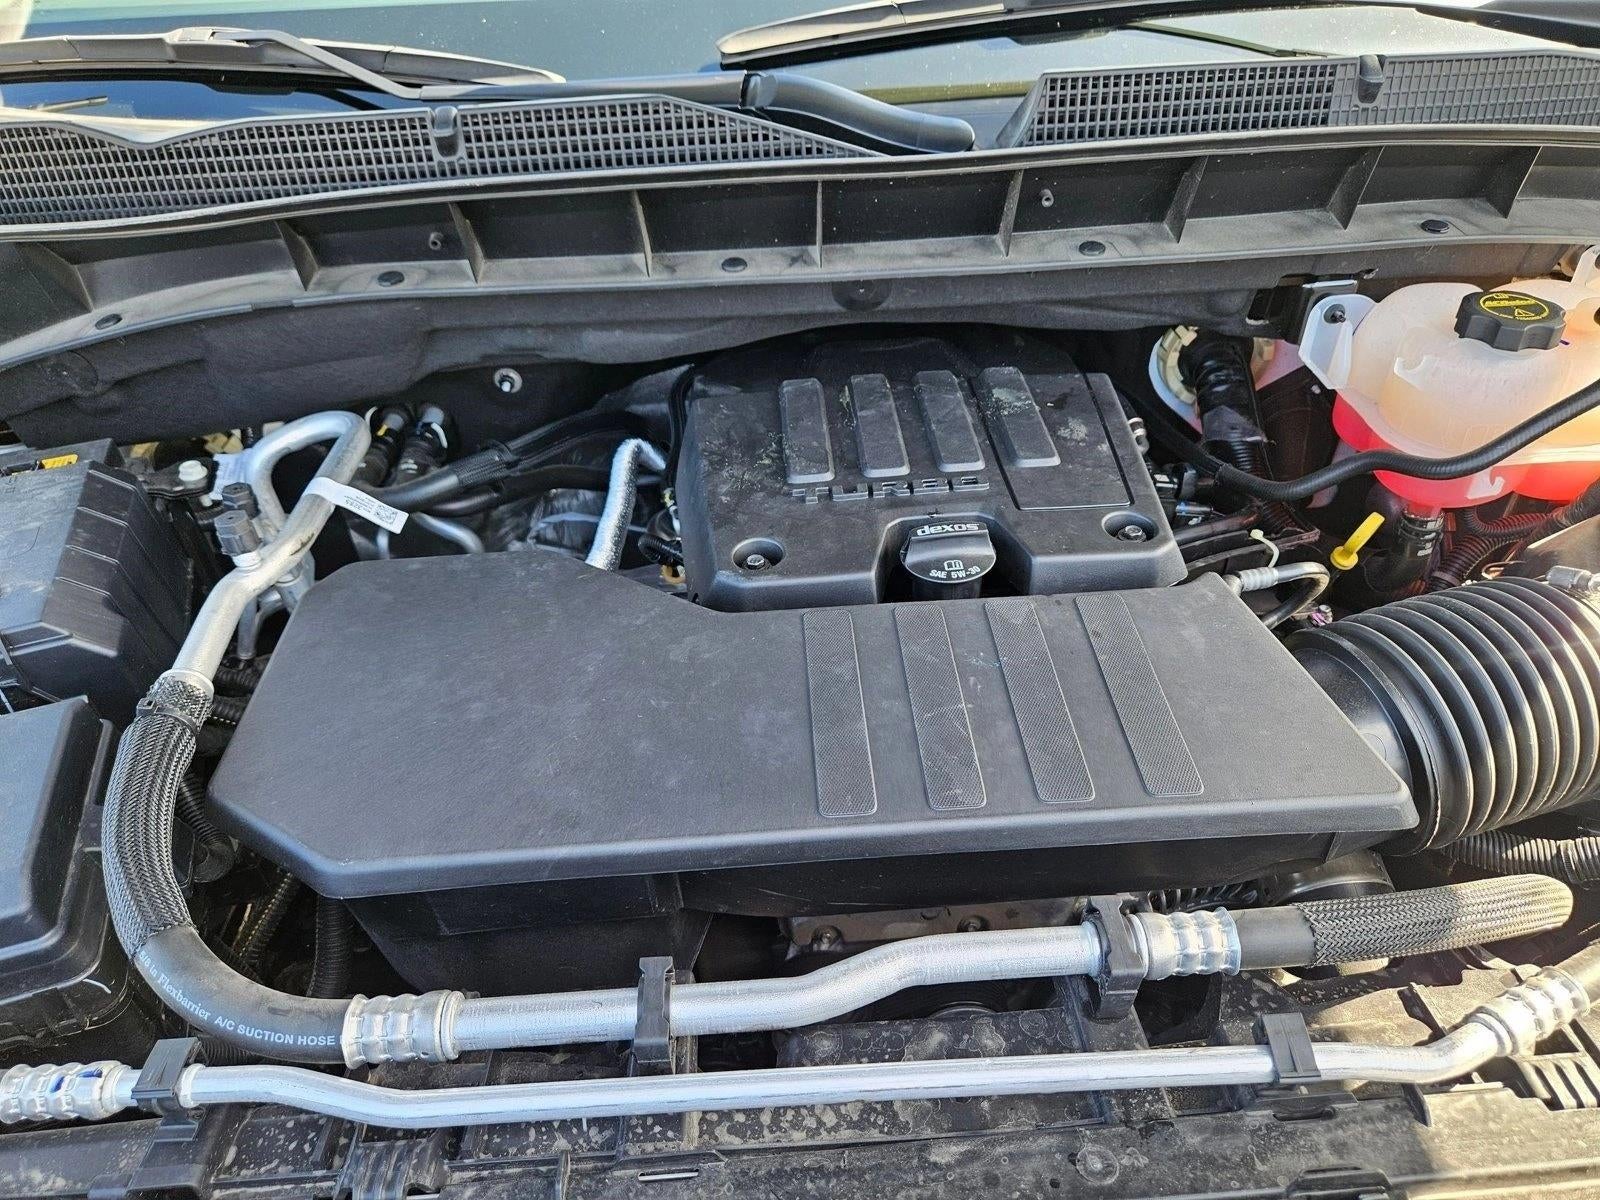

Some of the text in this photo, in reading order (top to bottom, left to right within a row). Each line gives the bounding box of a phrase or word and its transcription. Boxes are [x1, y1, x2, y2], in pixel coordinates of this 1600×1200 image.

[792, 476, 990, 504] TURBO
[916, 523, 980, 536] dexos
[929, 565, 981, 579] SAE 5W-30
[149, 964, 158, 977] in
[157, 973, 212, 1021] Flexbarrier
[214, 1015, 235, 1030] A/C
[237, 1024, 294, 1044] SUCTION
[297, 1035, 336, 1046] HOSE
